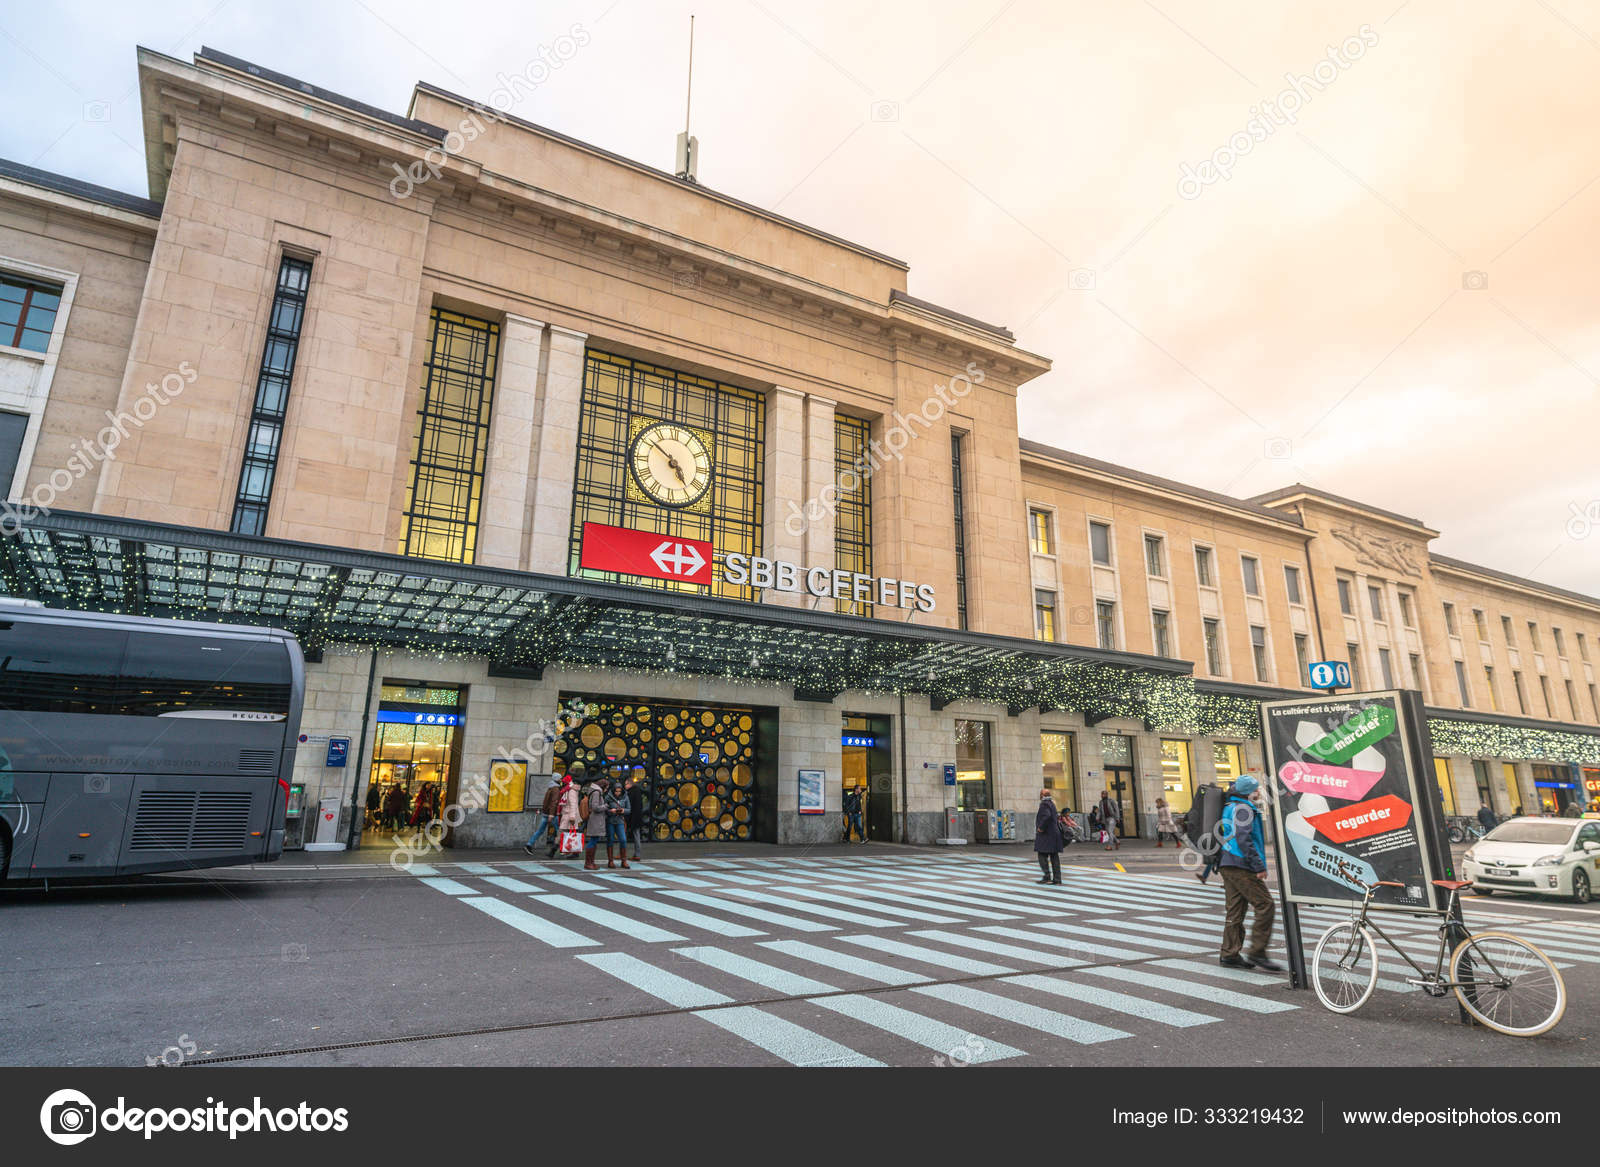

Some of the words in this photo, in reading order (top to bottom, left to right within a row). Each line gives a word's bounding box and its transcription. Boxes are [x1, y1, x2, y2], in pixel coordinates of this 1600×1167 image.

[724, 552, 799, 593] SBB
[806, 566, 872, 602] CFF
[878, 576, 936, 613] FFS
[1310, 706, 1323, 714] est
[1334, 717, 1381, 752] marcher
[1293, 770, 1349, 788] s'arrêter
[1335, 808, 1391, 830] regarder
[1308, 858, 1366, 889] cultul
